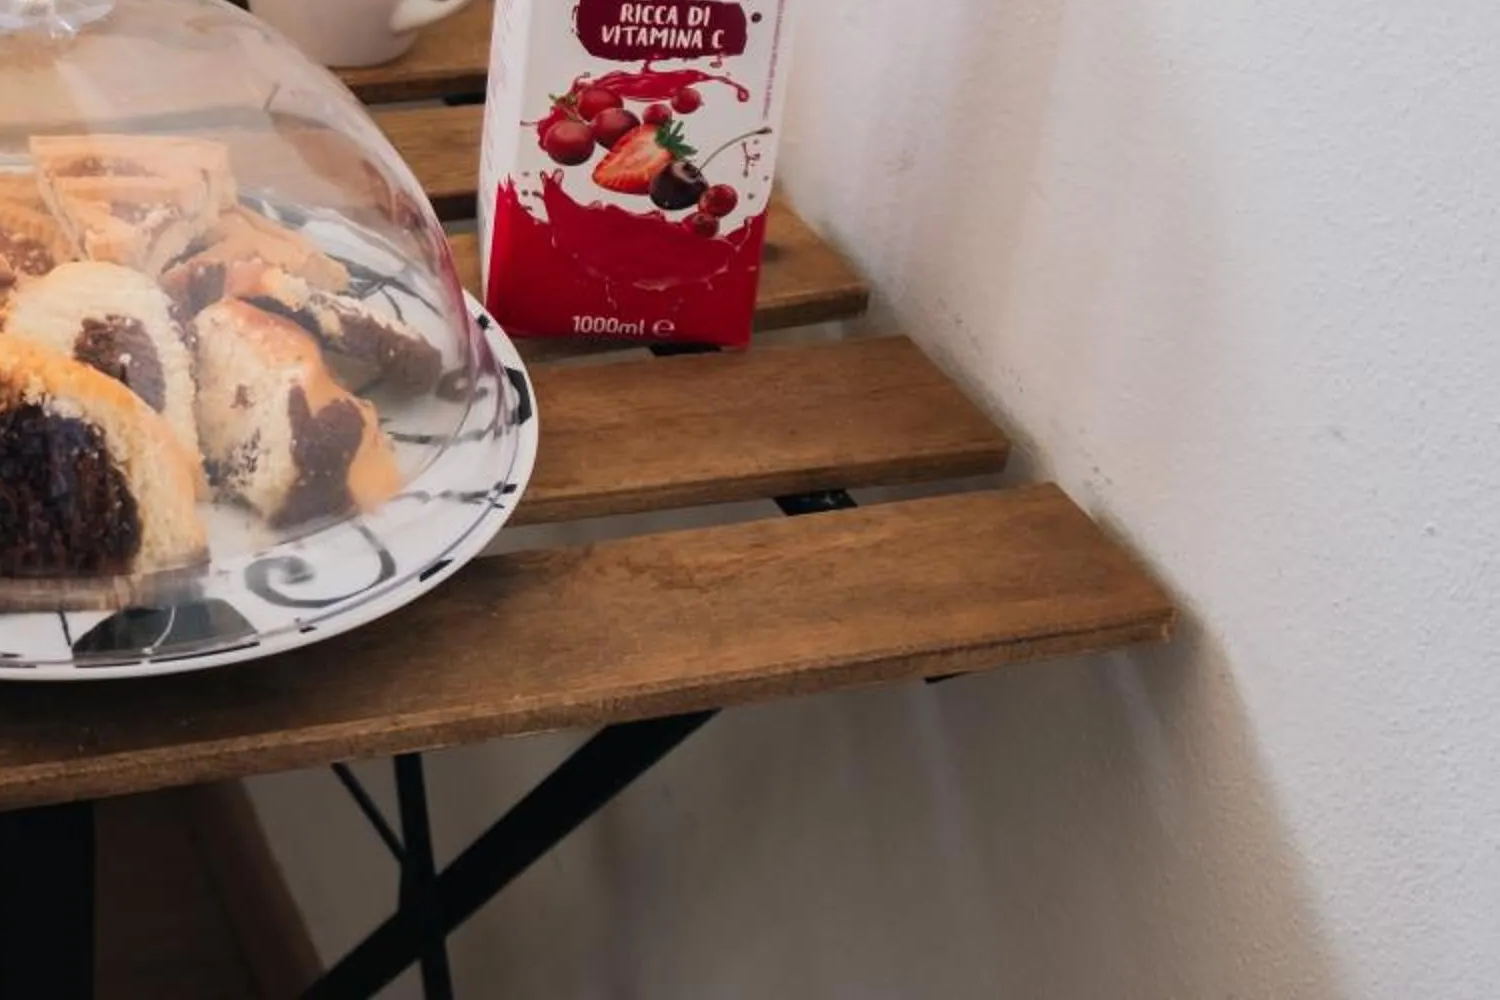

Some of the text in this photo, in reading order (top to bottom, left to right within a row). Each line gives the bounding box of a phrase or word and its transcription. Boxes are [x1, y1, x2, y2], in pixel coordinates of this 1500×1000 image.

[619, 2, 711, 27] RICCA DI
[601, 24, 725, 49] VITAMINA C
[572, 315, 645, 336] 1000ml
